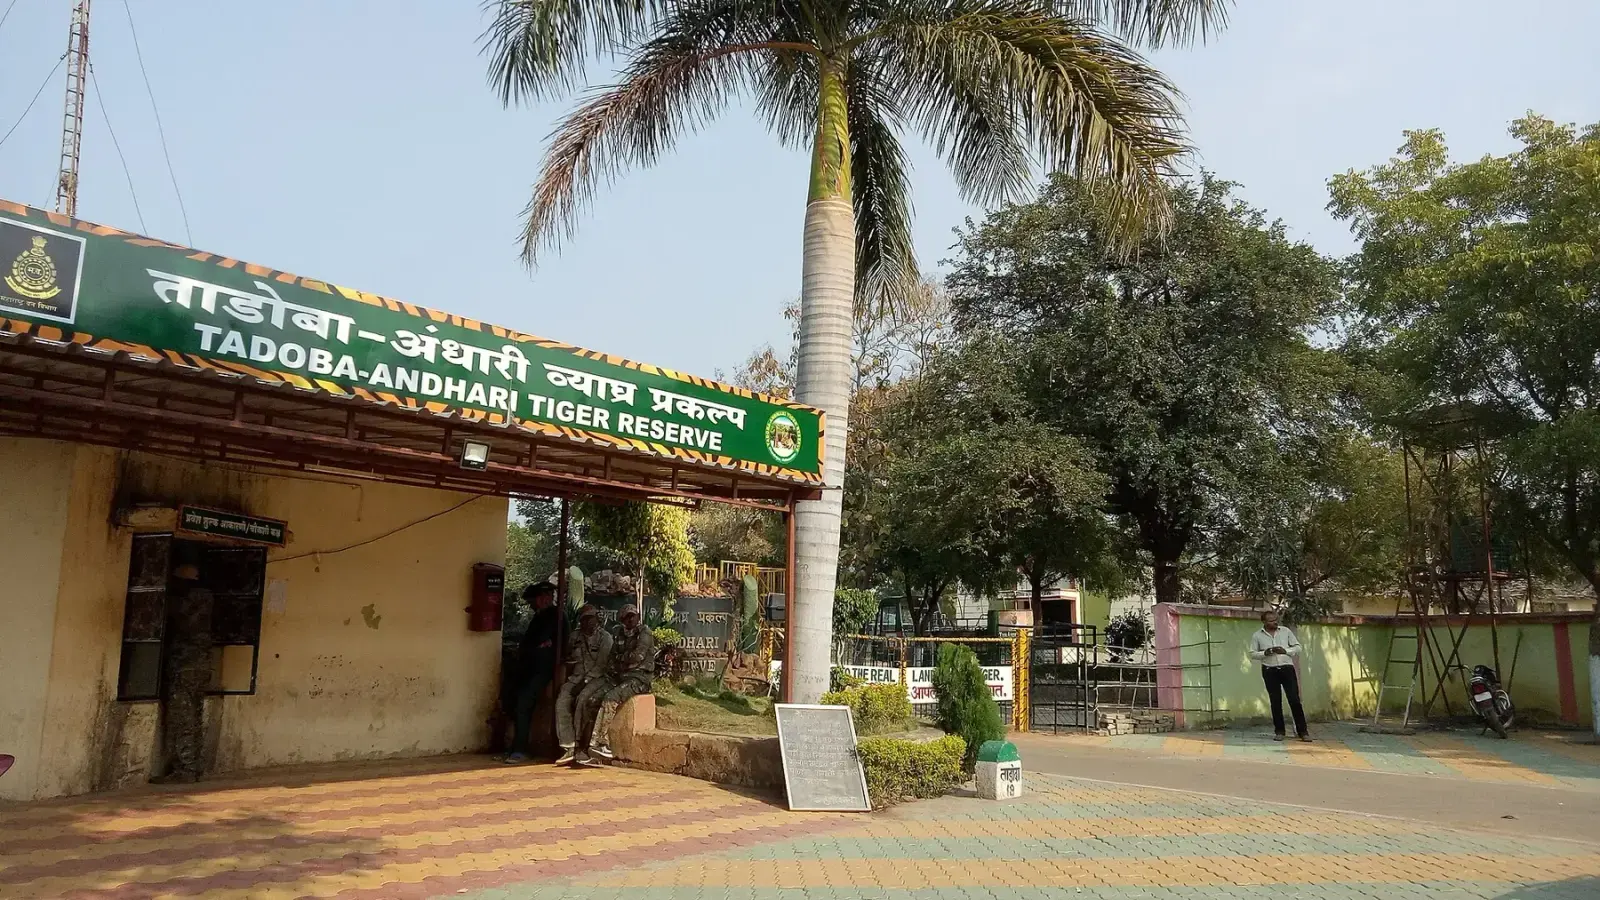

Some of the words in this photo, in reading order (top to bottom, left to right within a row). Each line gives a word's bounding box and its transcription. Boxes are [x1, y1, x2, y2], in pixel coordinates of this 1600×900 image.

[194, 322, 518, 412] TADOBA-ANDHARI
[528, 393, 610, 430] TIGER
[618, 412, 723, 451] RESERVE
[542, 362, 638, 406] व्याघ्र
[647, 387, 747, 431] प्रकल्प
[677, 636, 719, 649] DHARI
[852, 667, 869, 681] THE
[871, 669, 896, 682] REAL
[982, 669, 1004, 681] GER.
